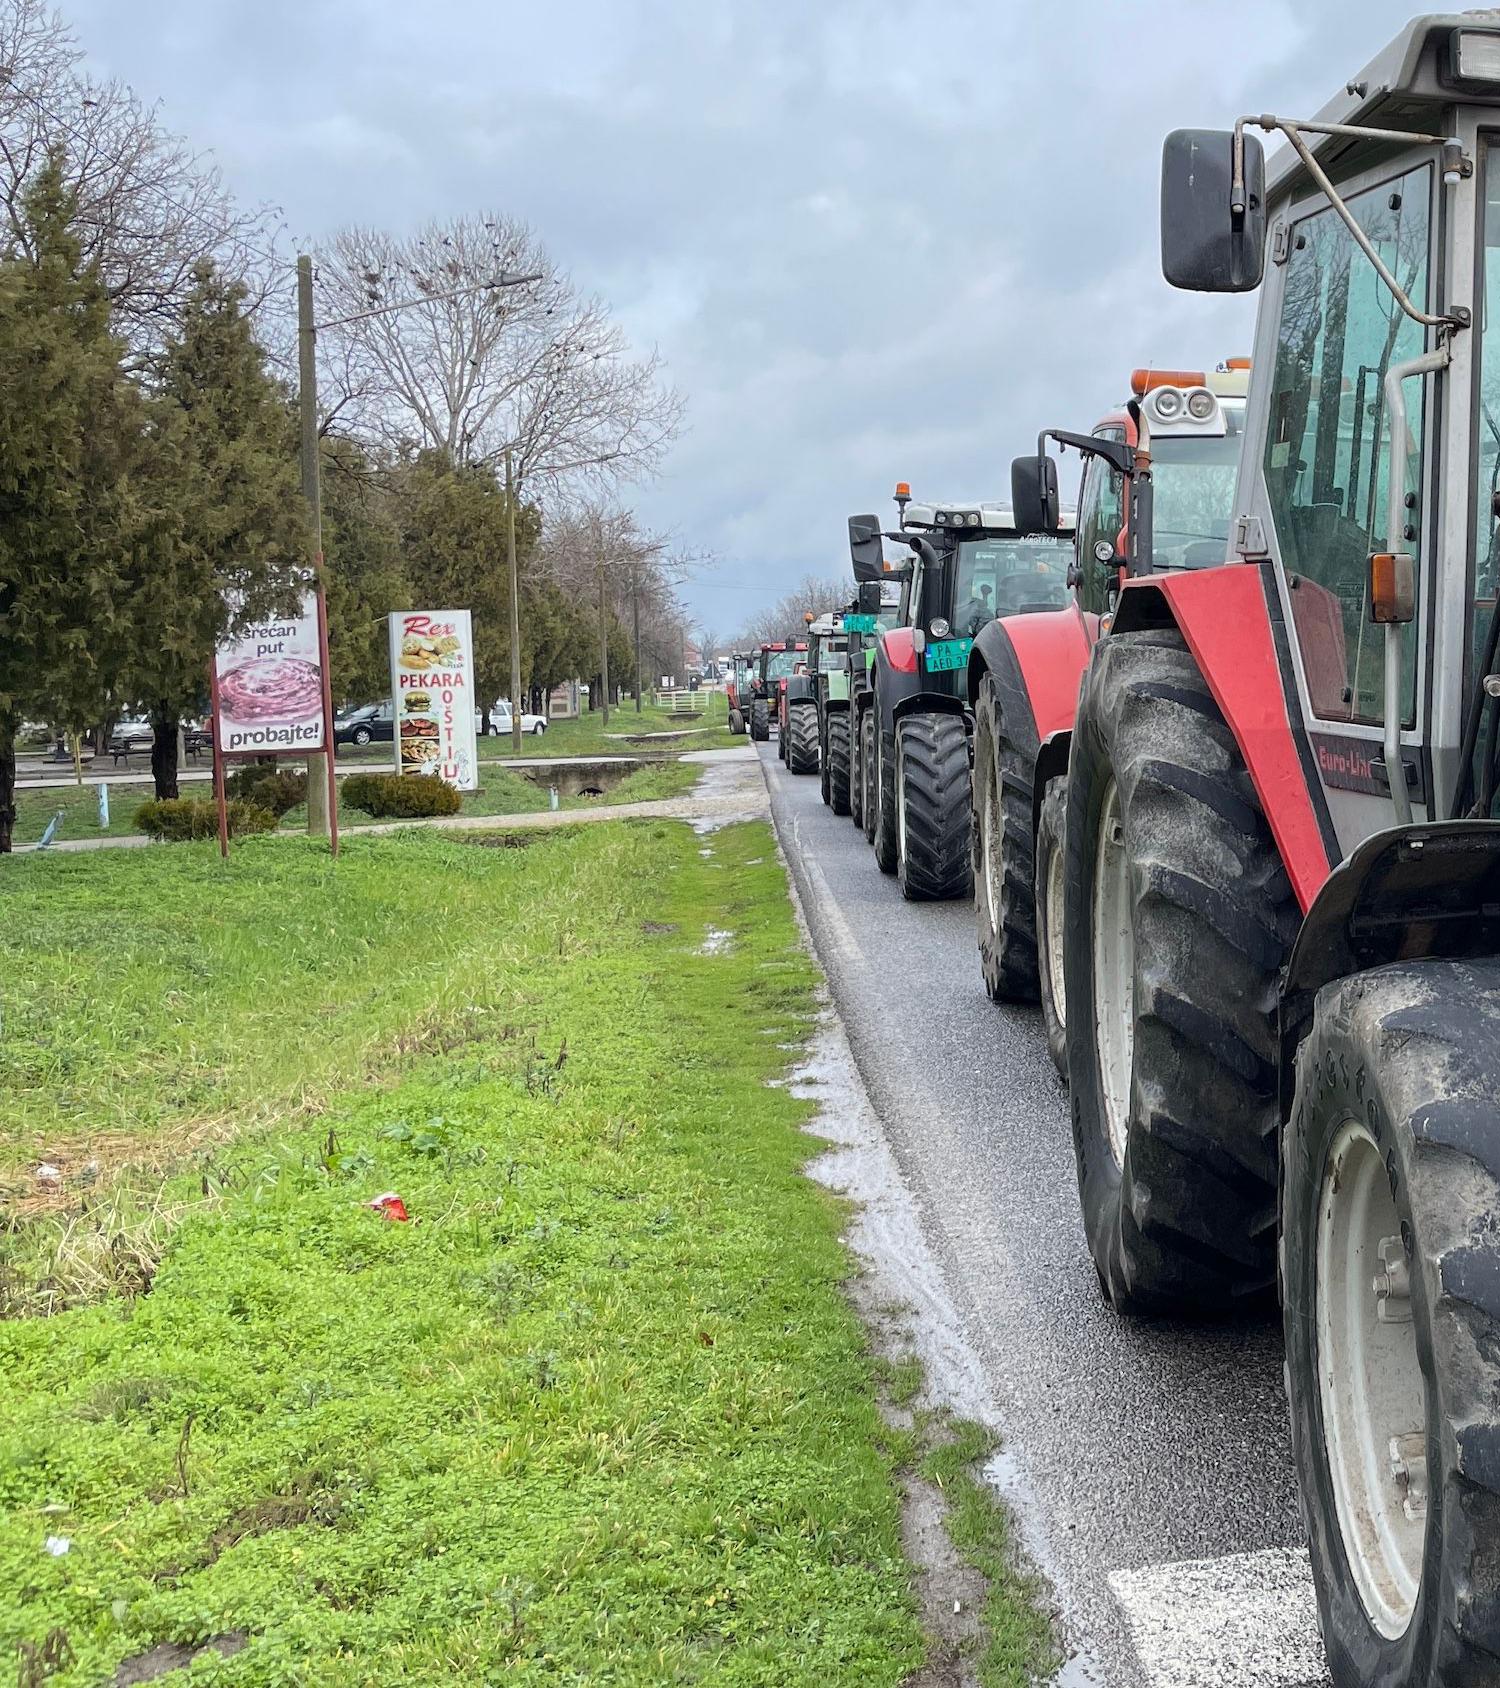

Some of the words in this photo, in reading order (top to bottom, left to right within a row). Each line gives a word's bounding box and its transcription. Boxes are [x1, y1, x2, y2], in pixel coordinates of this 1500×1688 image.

[243, 623, 297, 640] srećan
[257, 641, 285, 657] put
[399, 672, 464, 689] PEKARA
[229, 723, 320, 750] probajte!
